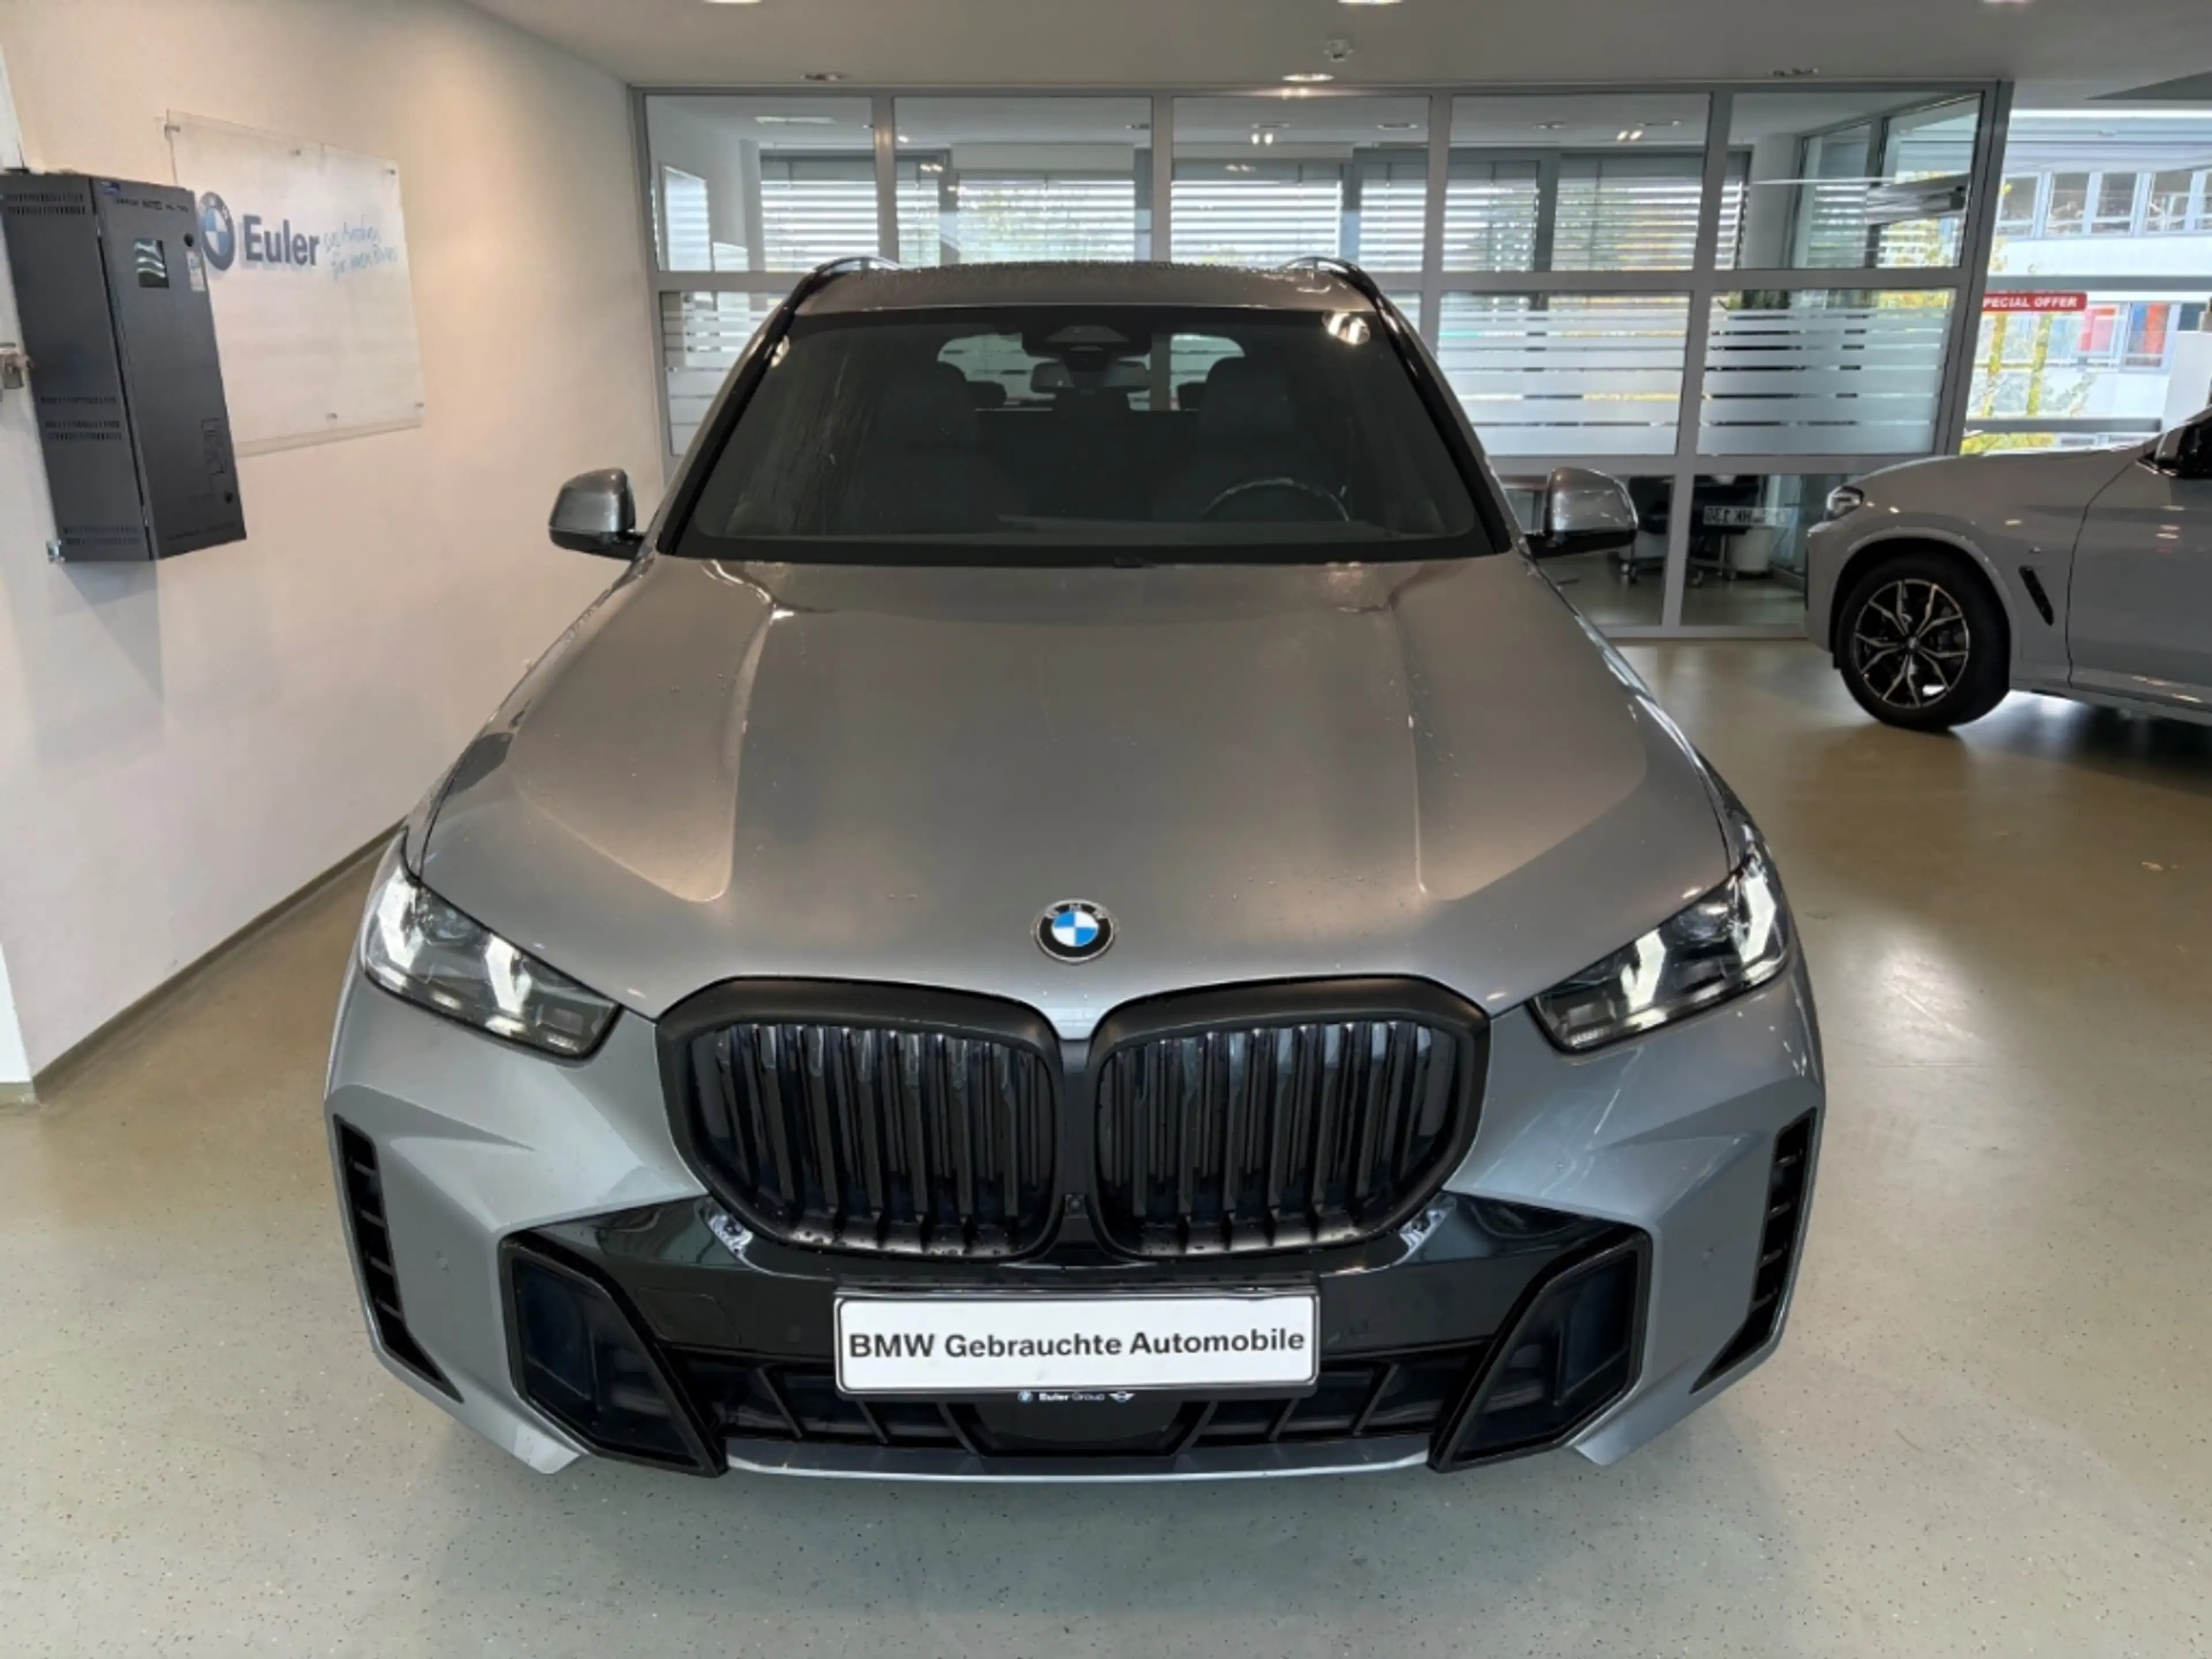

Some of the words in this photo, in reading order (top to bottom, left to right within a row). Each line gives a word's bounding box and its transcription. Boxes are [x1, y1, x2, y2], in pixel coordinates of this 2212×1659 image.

[243, 214, 320, 267] Euler
[1983, 296, 2031, 308] PECIAL
[2033, 297, 2077, 308] OFFER
[849, 1333, 935, 1358] BMW
[945, 1332, 1122, 1358] Gebrauchte
[1130, 1327, 1305, 1355] Automobile
[1039, 1392, 1069, 1402] Euler
